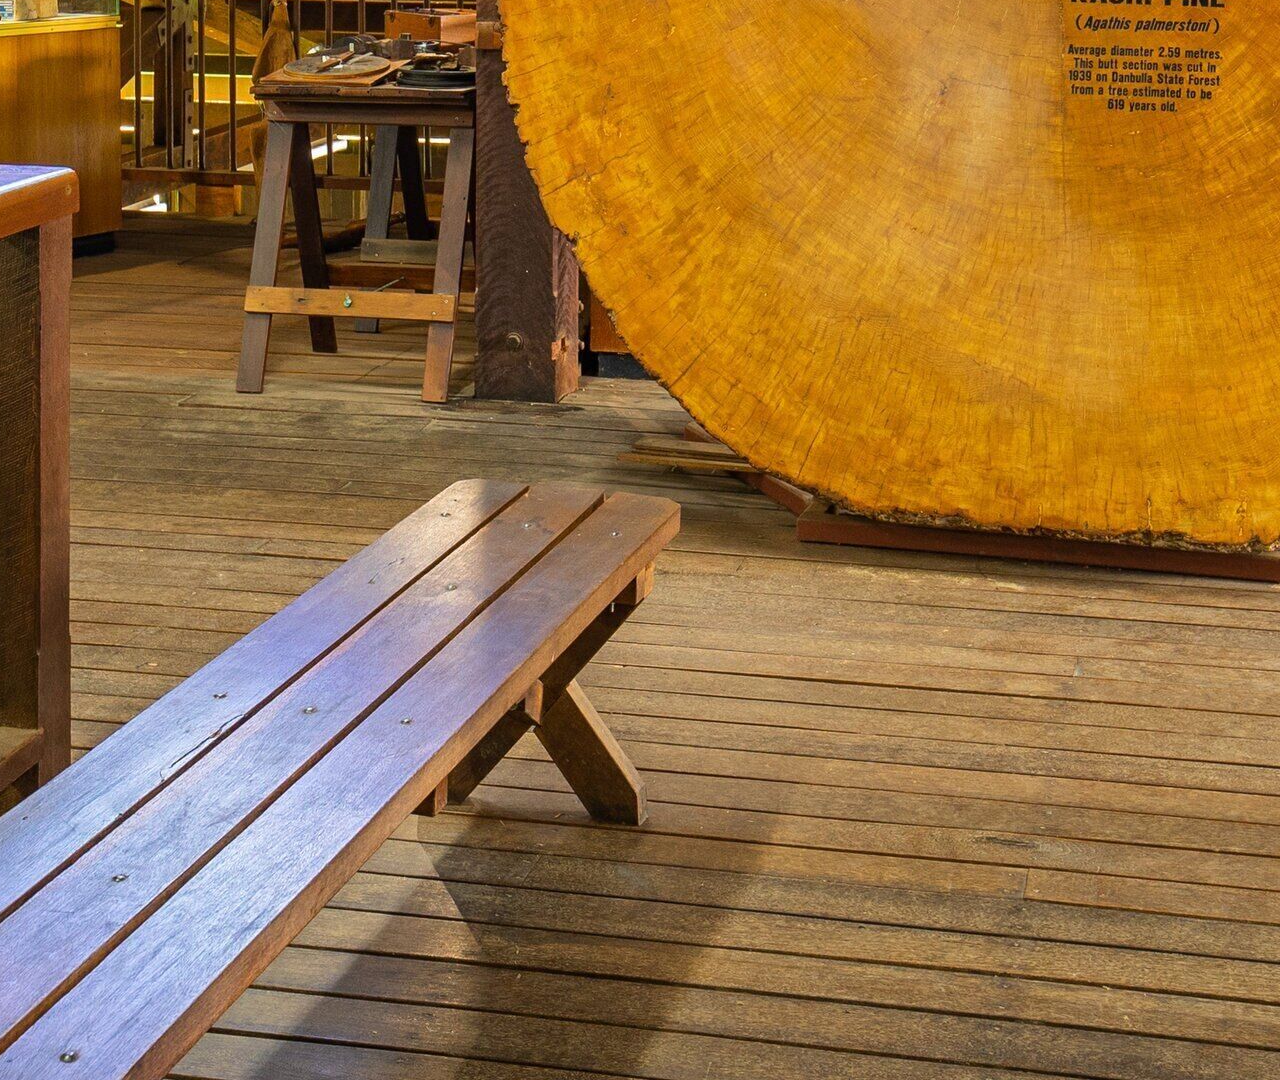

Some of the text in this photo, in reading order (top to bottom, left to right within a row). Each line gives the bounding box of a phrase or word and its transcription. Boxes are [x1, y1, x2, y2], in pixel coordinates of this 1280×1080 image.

[1068, 44, 1223, 59] Average diameter 2.59 metres.
[1074, 58, 1216, 72] This butt section was cut in
[1069, 70, 1220, 86] 1939 on Danbulla State Forest
[1071, 84, 1212, 99] from a tree estimated to be
[1107, 99, 1178, 112] 619 years old.
